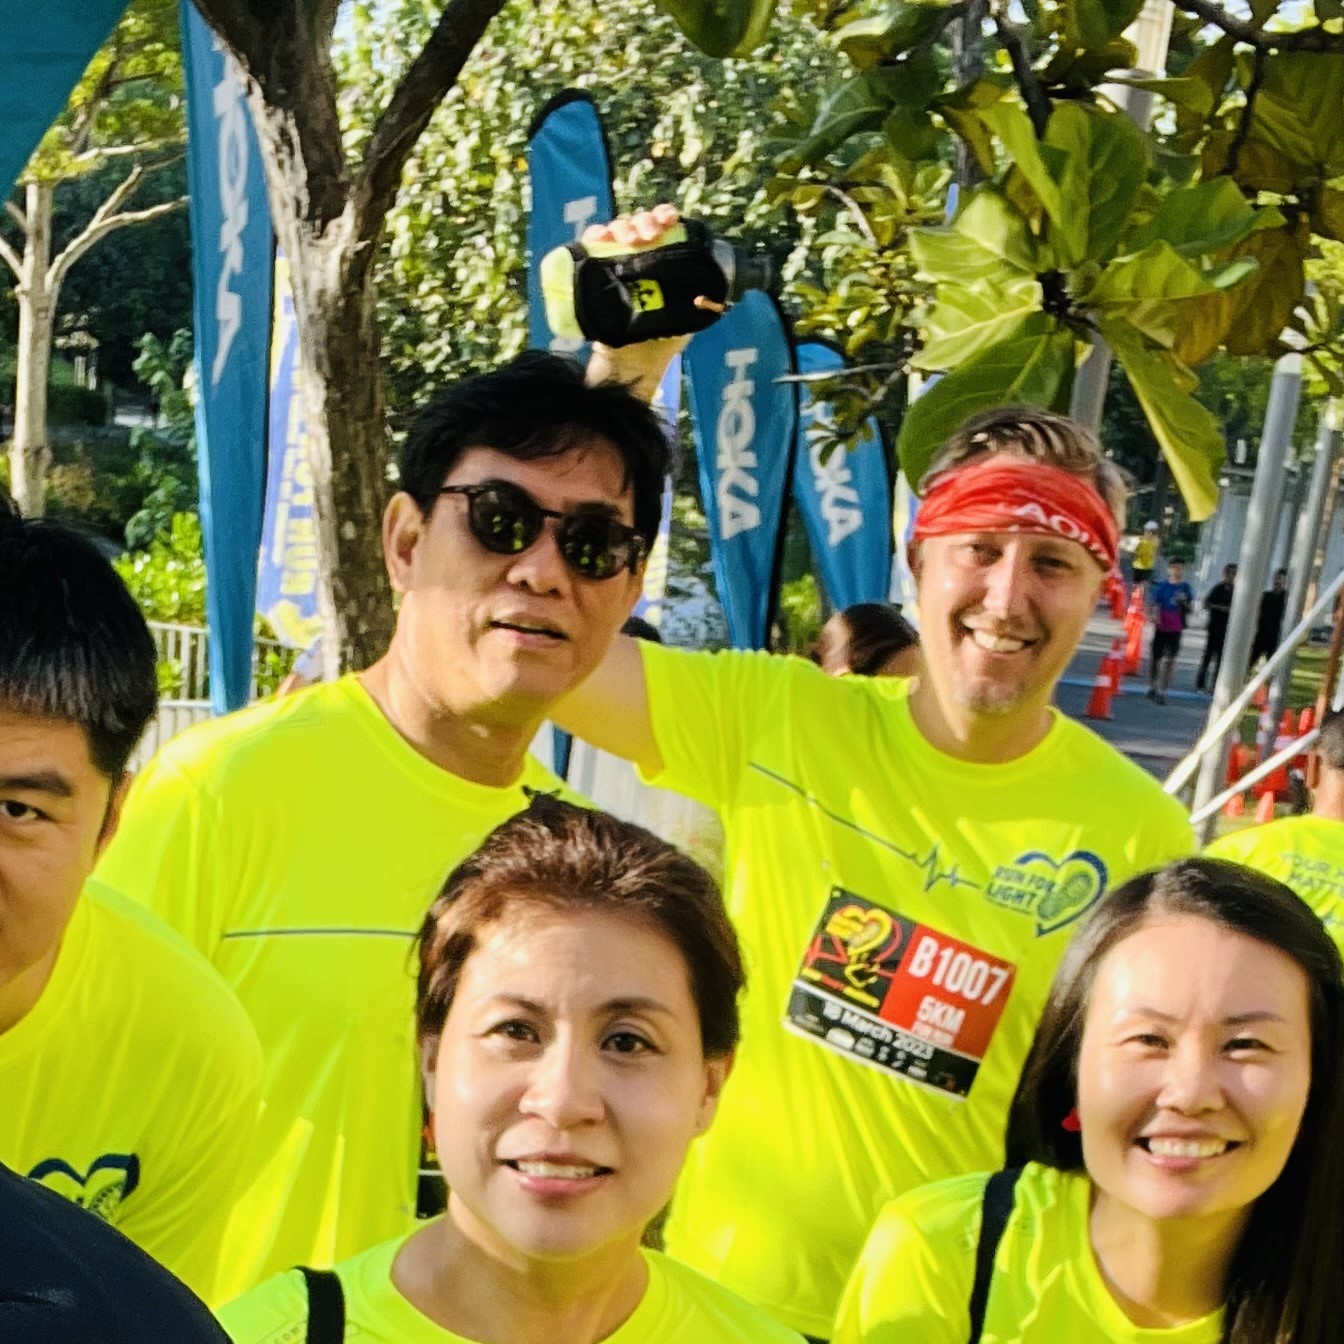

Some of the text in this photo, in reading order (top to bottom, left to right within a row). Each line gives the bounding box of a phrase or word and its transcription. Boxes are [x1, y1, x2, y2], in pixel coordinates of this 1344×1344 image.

[716, 348, 761, 541] HOKA
[908, 935, 1009, 1006] B1007
[841, 1010, 894, 1044] March
[893, 1032, 935, 1061] 2023
